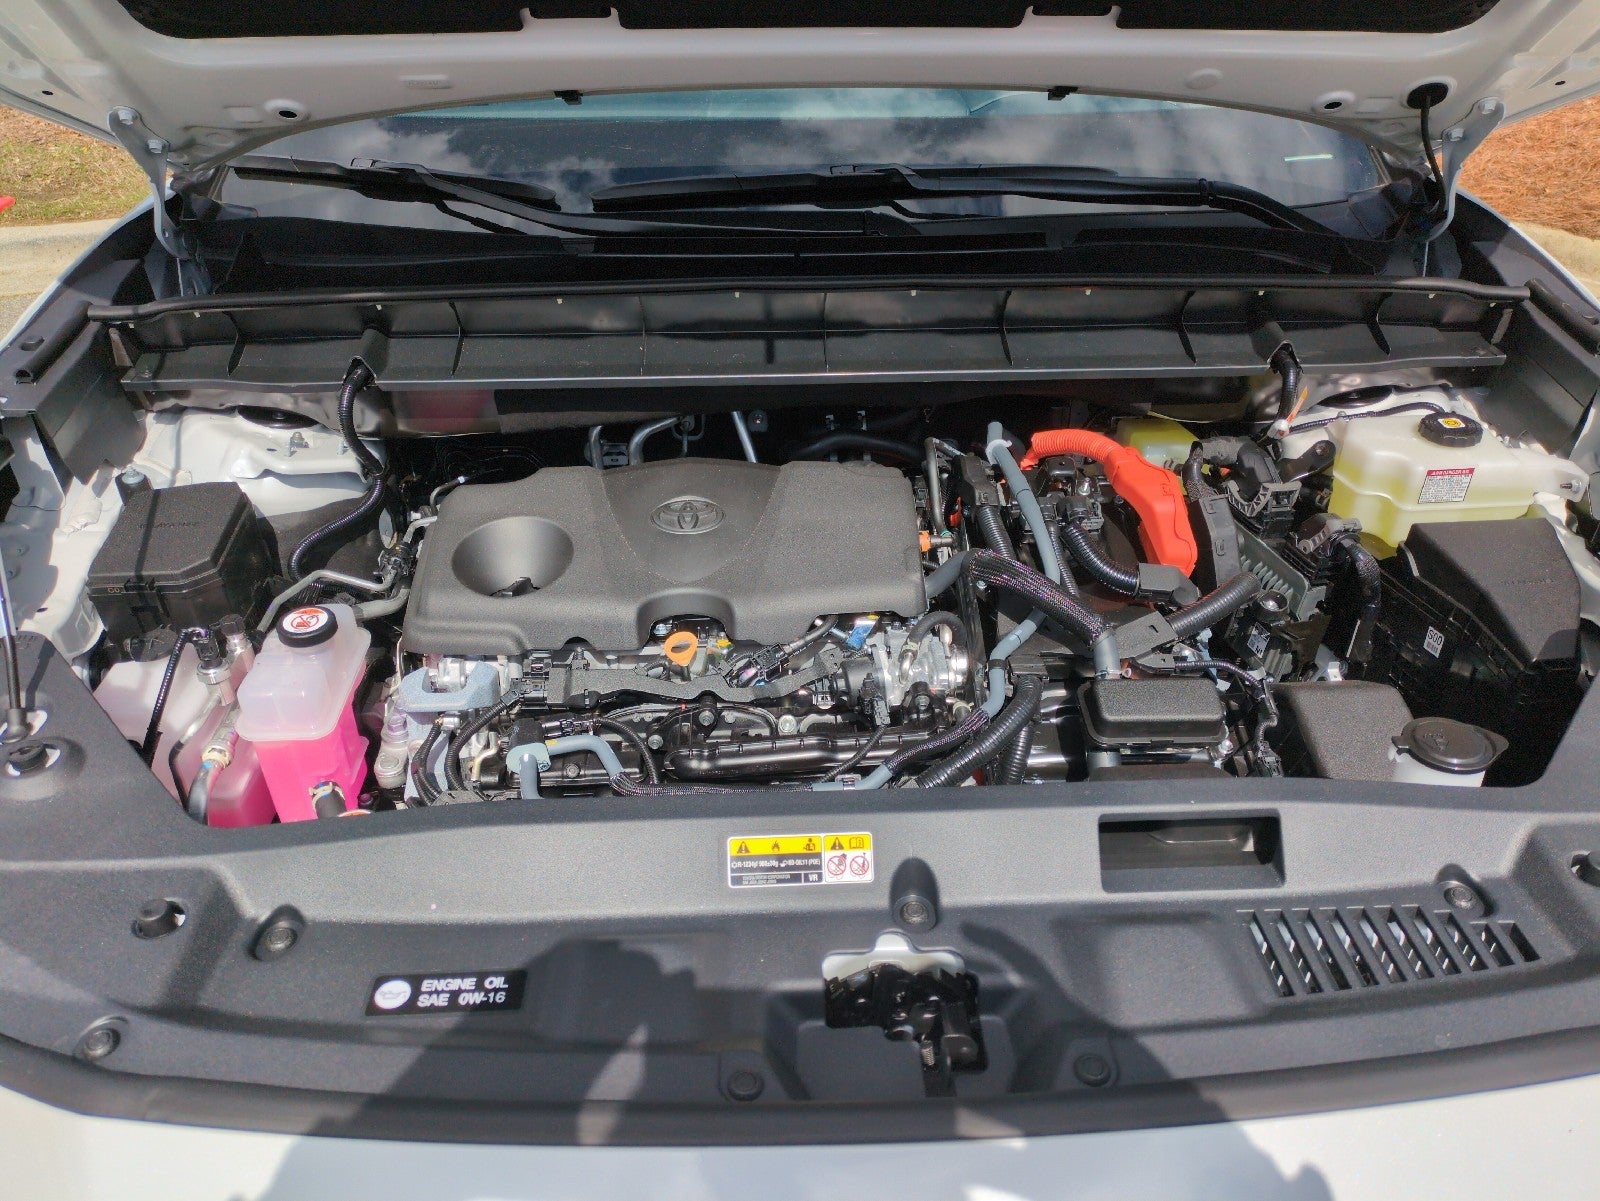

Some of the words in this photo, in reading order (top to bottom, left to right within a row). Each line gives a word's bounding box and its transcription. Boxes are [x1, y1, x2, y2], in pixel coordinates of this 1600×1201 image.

[808, 873, 819, 882] VR
[420, 977, 477, 992] ENGINE
[484, 976, 509, 990] OIL
[417, 993, 450, 1007] SAE
[458, 991, 506, 1006] 0W-16
